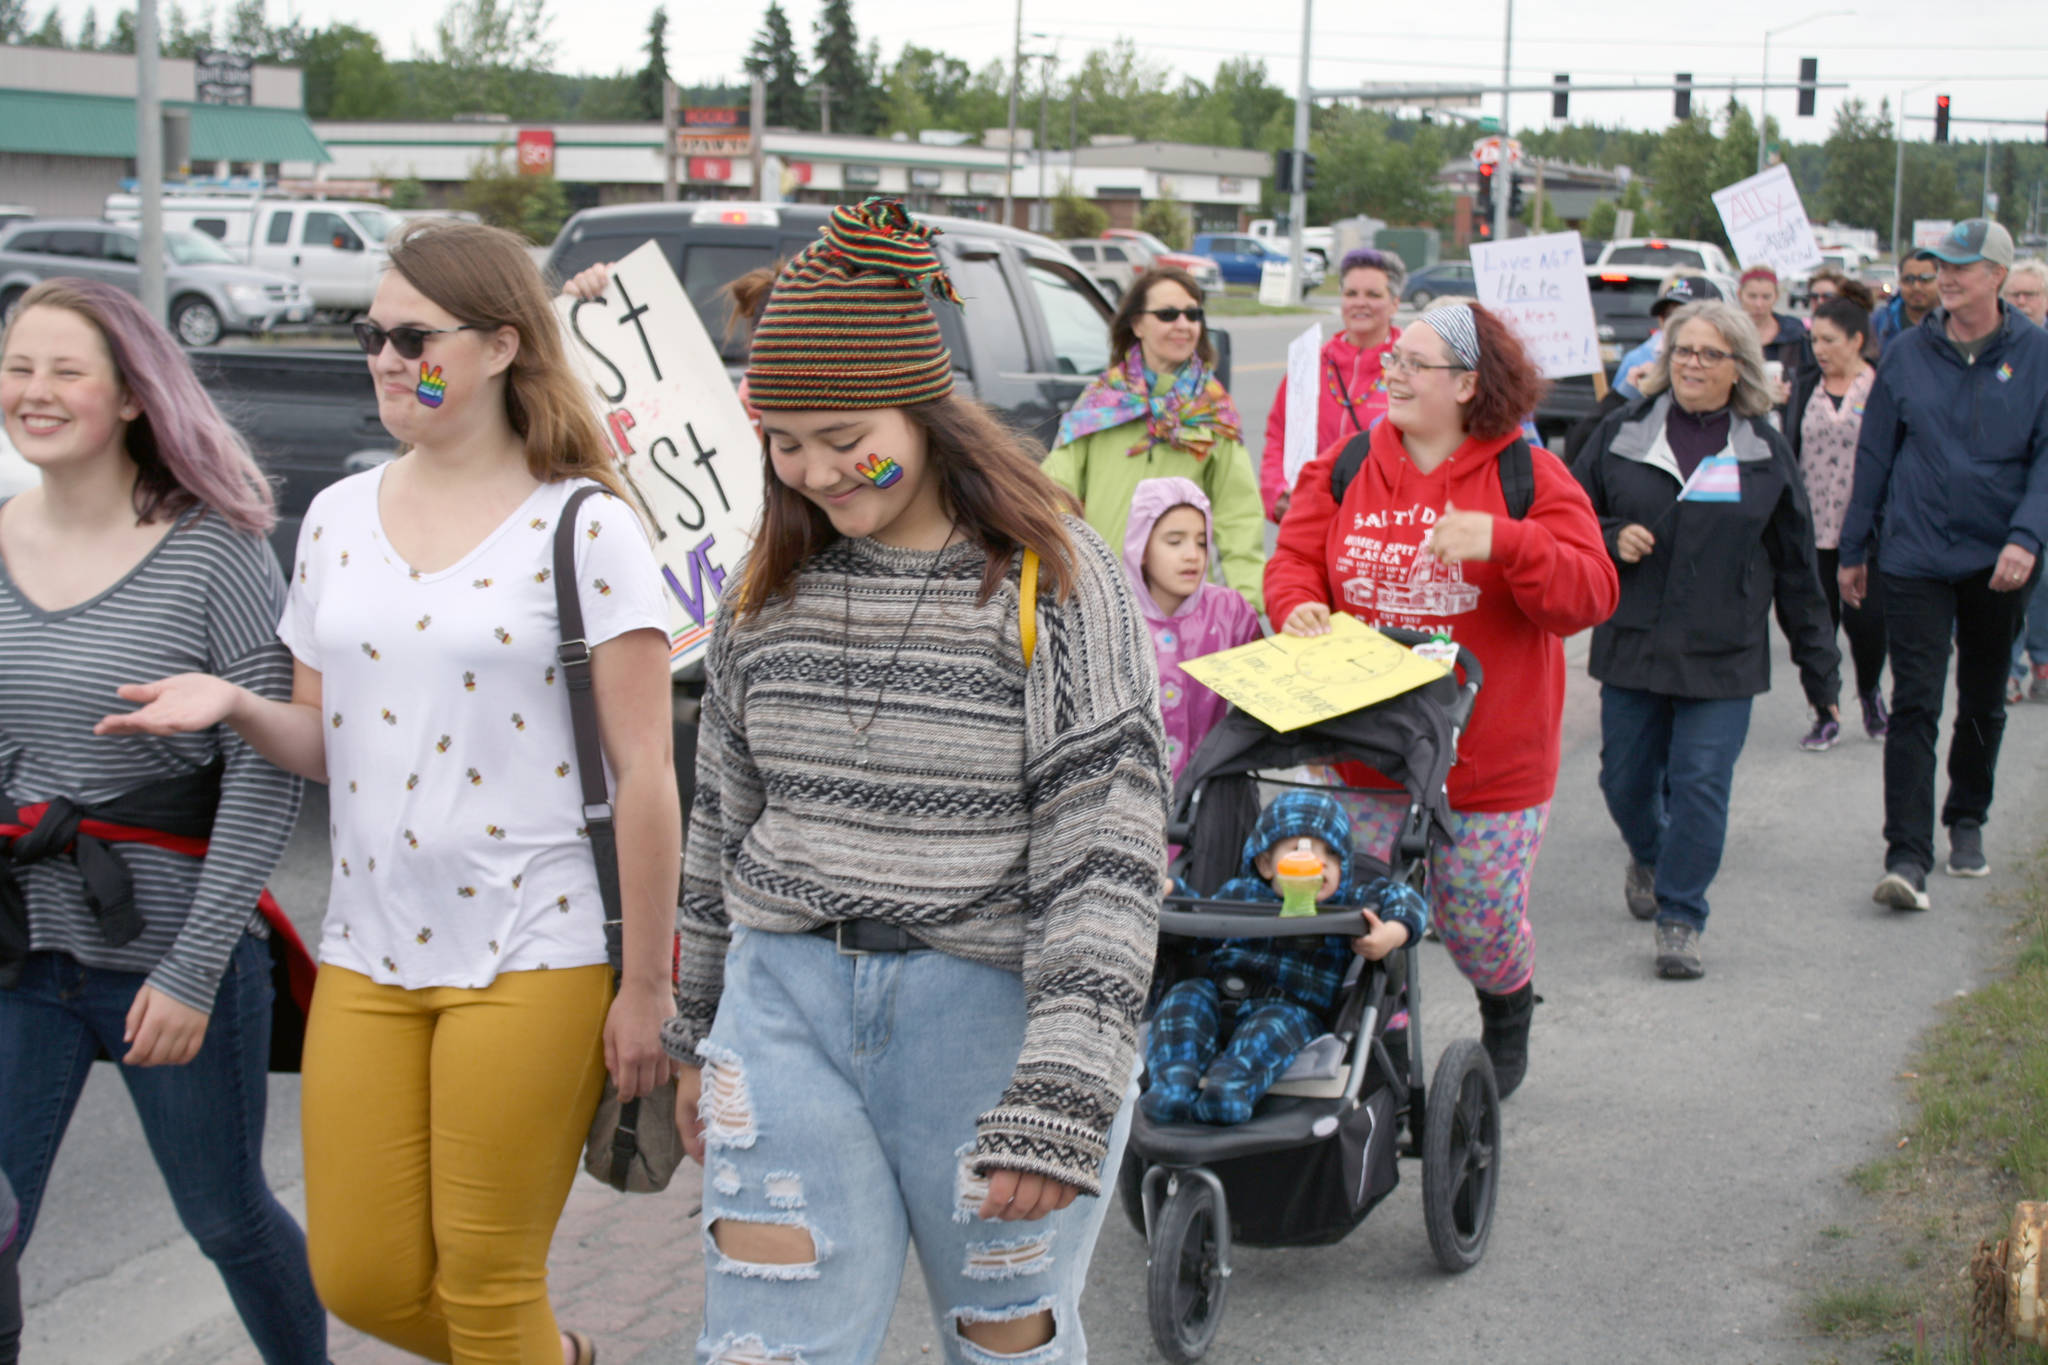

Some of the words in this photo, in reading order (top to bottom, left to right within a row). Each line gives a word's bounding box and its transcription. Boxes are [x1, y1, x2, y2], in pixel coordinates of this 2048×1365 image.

[1497, 272, 1561, 300] Hate
[1354, 504, 1420, 531] SALTY
[1346, 547, 1401, 566] ALASKA
[1385, 543, 1416, 557] SPIT
